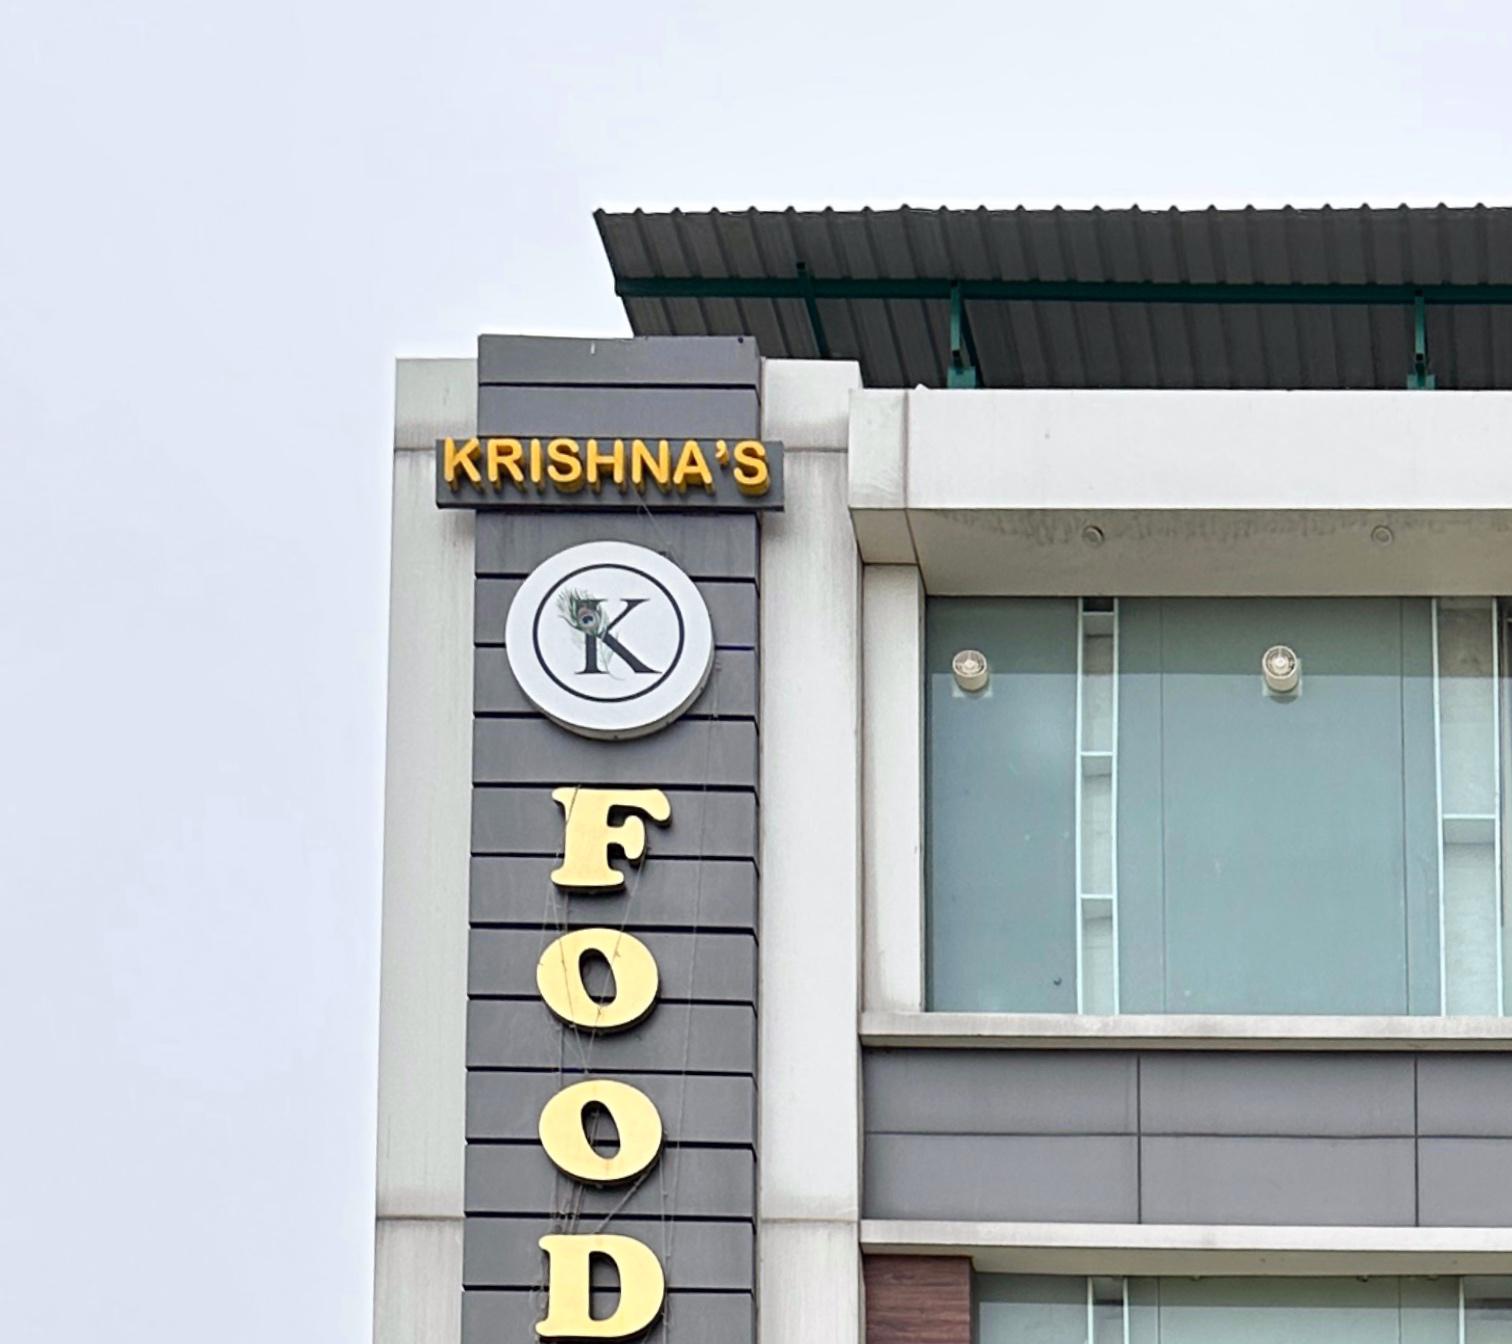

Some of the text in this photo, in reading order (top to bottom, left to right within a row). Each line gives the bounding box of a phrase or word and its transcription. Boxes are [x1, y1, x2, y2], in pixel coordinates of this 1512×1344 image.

[443, 437, 771, 491] KRISHNA'S
[571, 597, 663, 675] K
[537, 787, 666, 1339] FOOD
